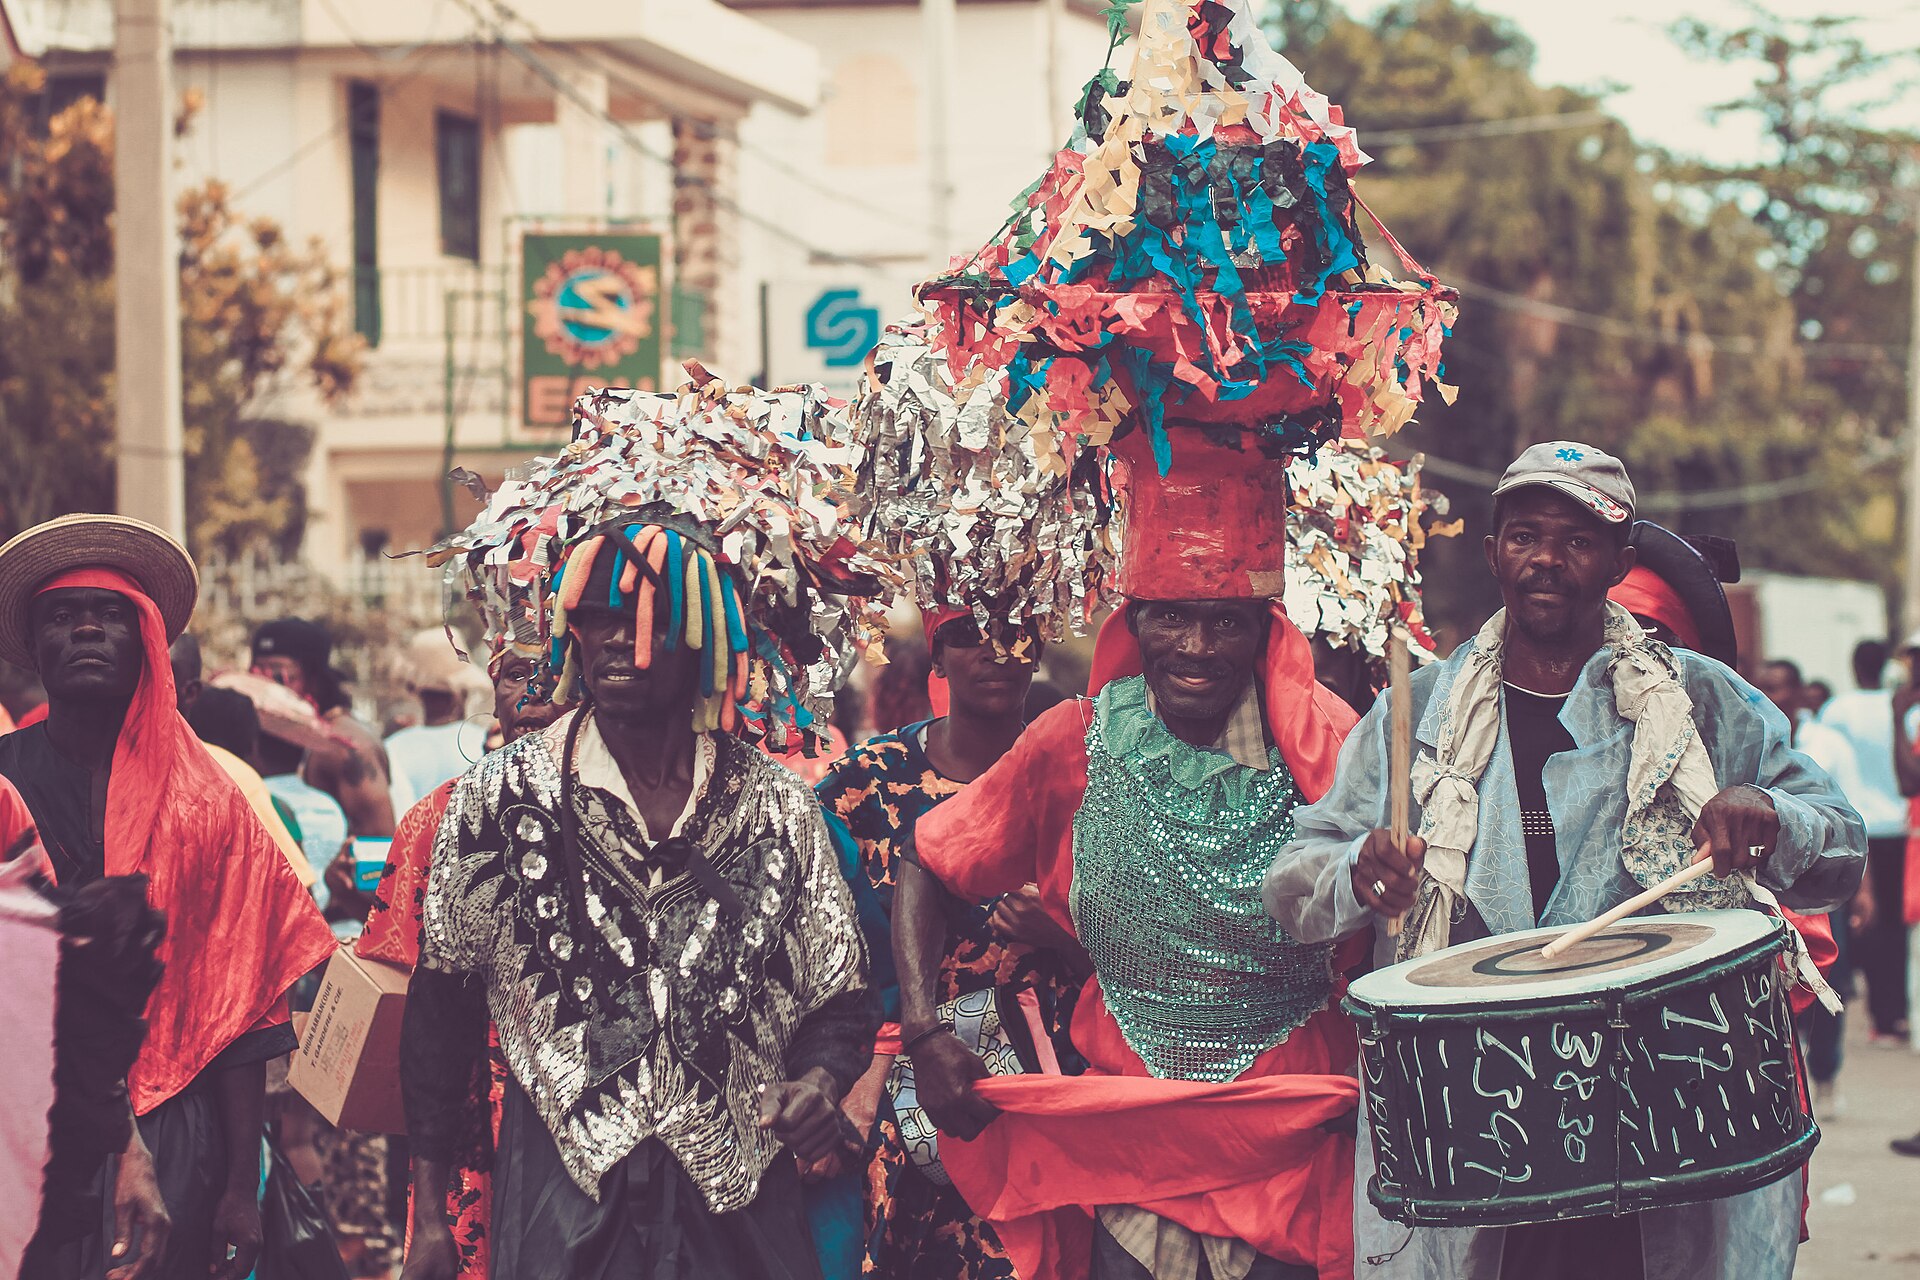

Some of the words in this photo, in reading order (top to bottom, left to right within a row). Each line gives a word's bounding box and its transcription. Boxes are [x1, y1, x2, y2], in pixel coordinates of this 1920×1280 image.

[1553, 460, 1577, 469] EMS
[303, 1032, 315, 1056] RHUM
[311, 980, 333, 1033] BARBANCOURT
[310, 1059, 317, 1068] T.
[314, 1012, 332, 1058] GARDERE
[1551, 1022, 1602, 1164] 3830
